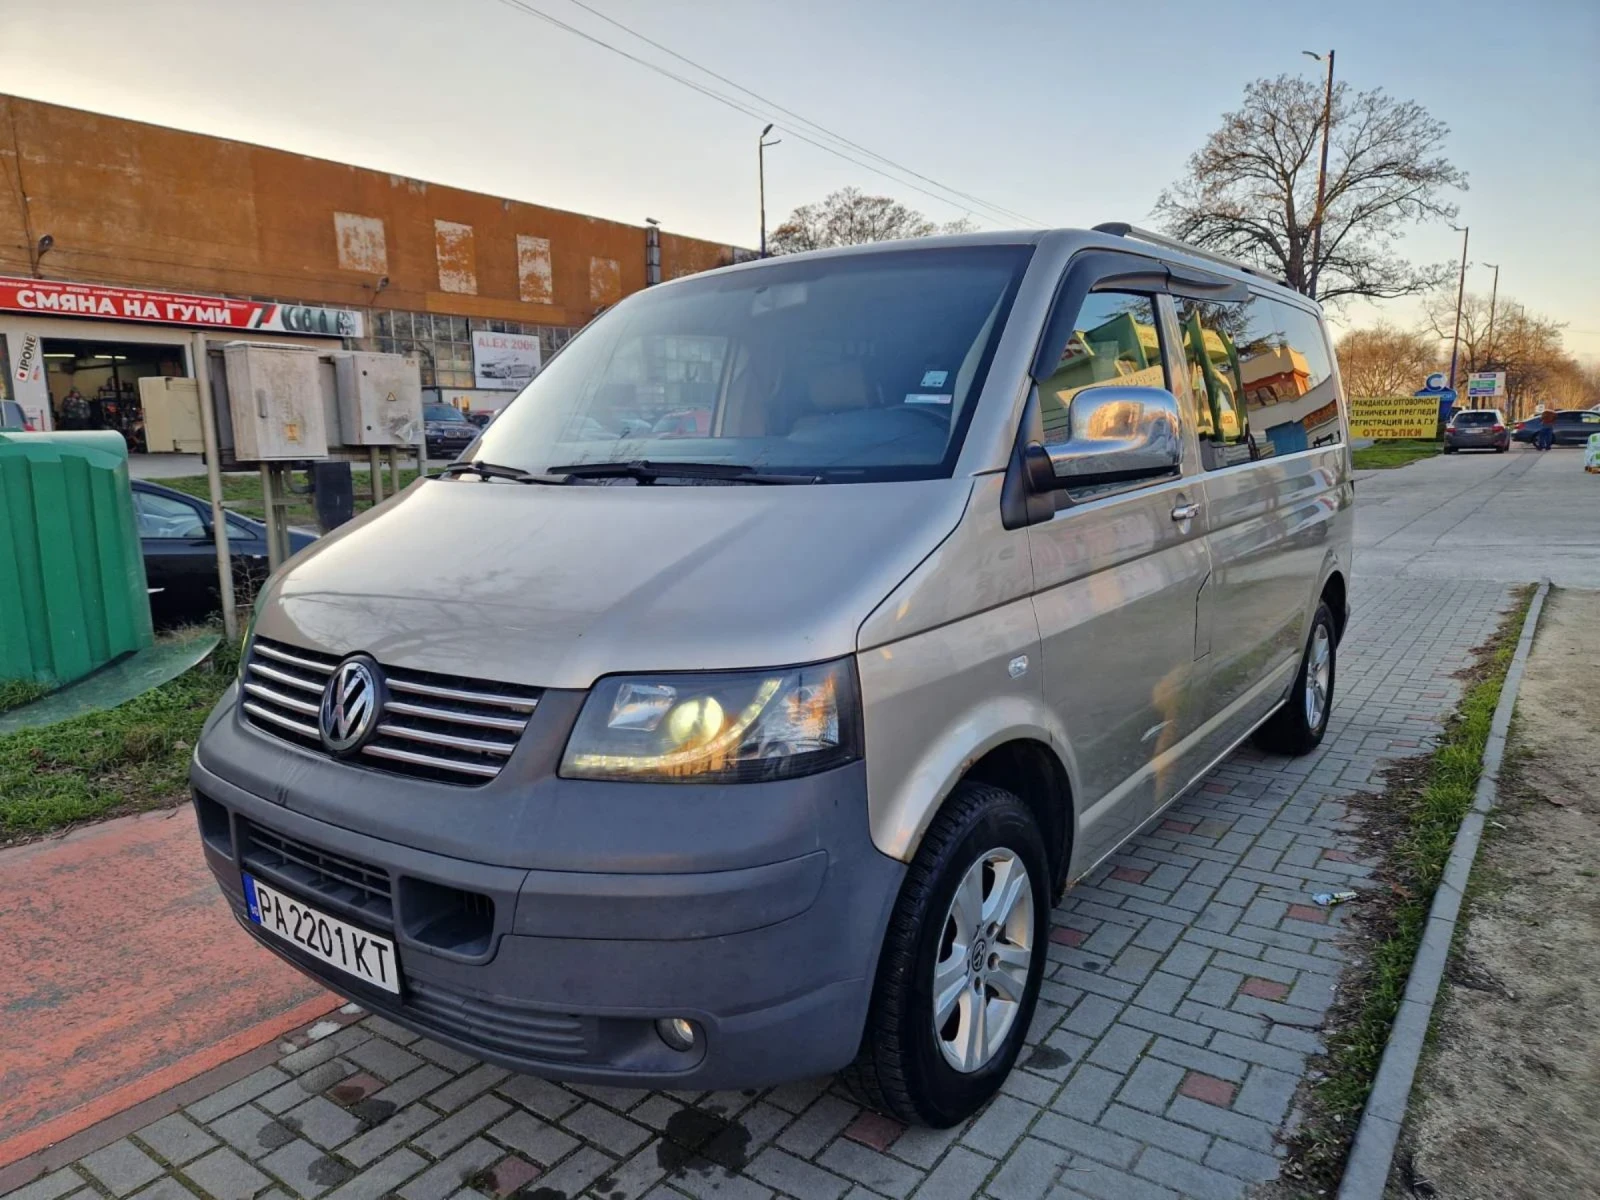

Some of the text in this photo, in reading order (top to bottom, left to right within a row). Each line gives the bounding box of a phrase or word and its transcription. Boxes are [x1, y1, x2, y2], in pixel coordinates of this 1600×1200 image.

[16, 289, 117, 315] СМЯНА
[123, 299, 161, 319] НА
[166, 303, 232, 325] ГУМИ
[478, 337, 508, 350] ALEX
[19, 335, 37, 371] IPONE
[1352, 398, 1438, 407] ГРАЖДАНСКА ОТГОВОРНОСТ
[1352, 408, 1437, 417] ТЕХНИЧЕСКИ ПРЕГЛЕДИ
[1350, 418, 1403, 427] РЕГИСТРАЦИЯ
[1404, 418, 1415, 426] НА
[1362, 428, 1422, 437] ОТСТЪПКИ
[256, 886, 389, 984] PA2201KT
